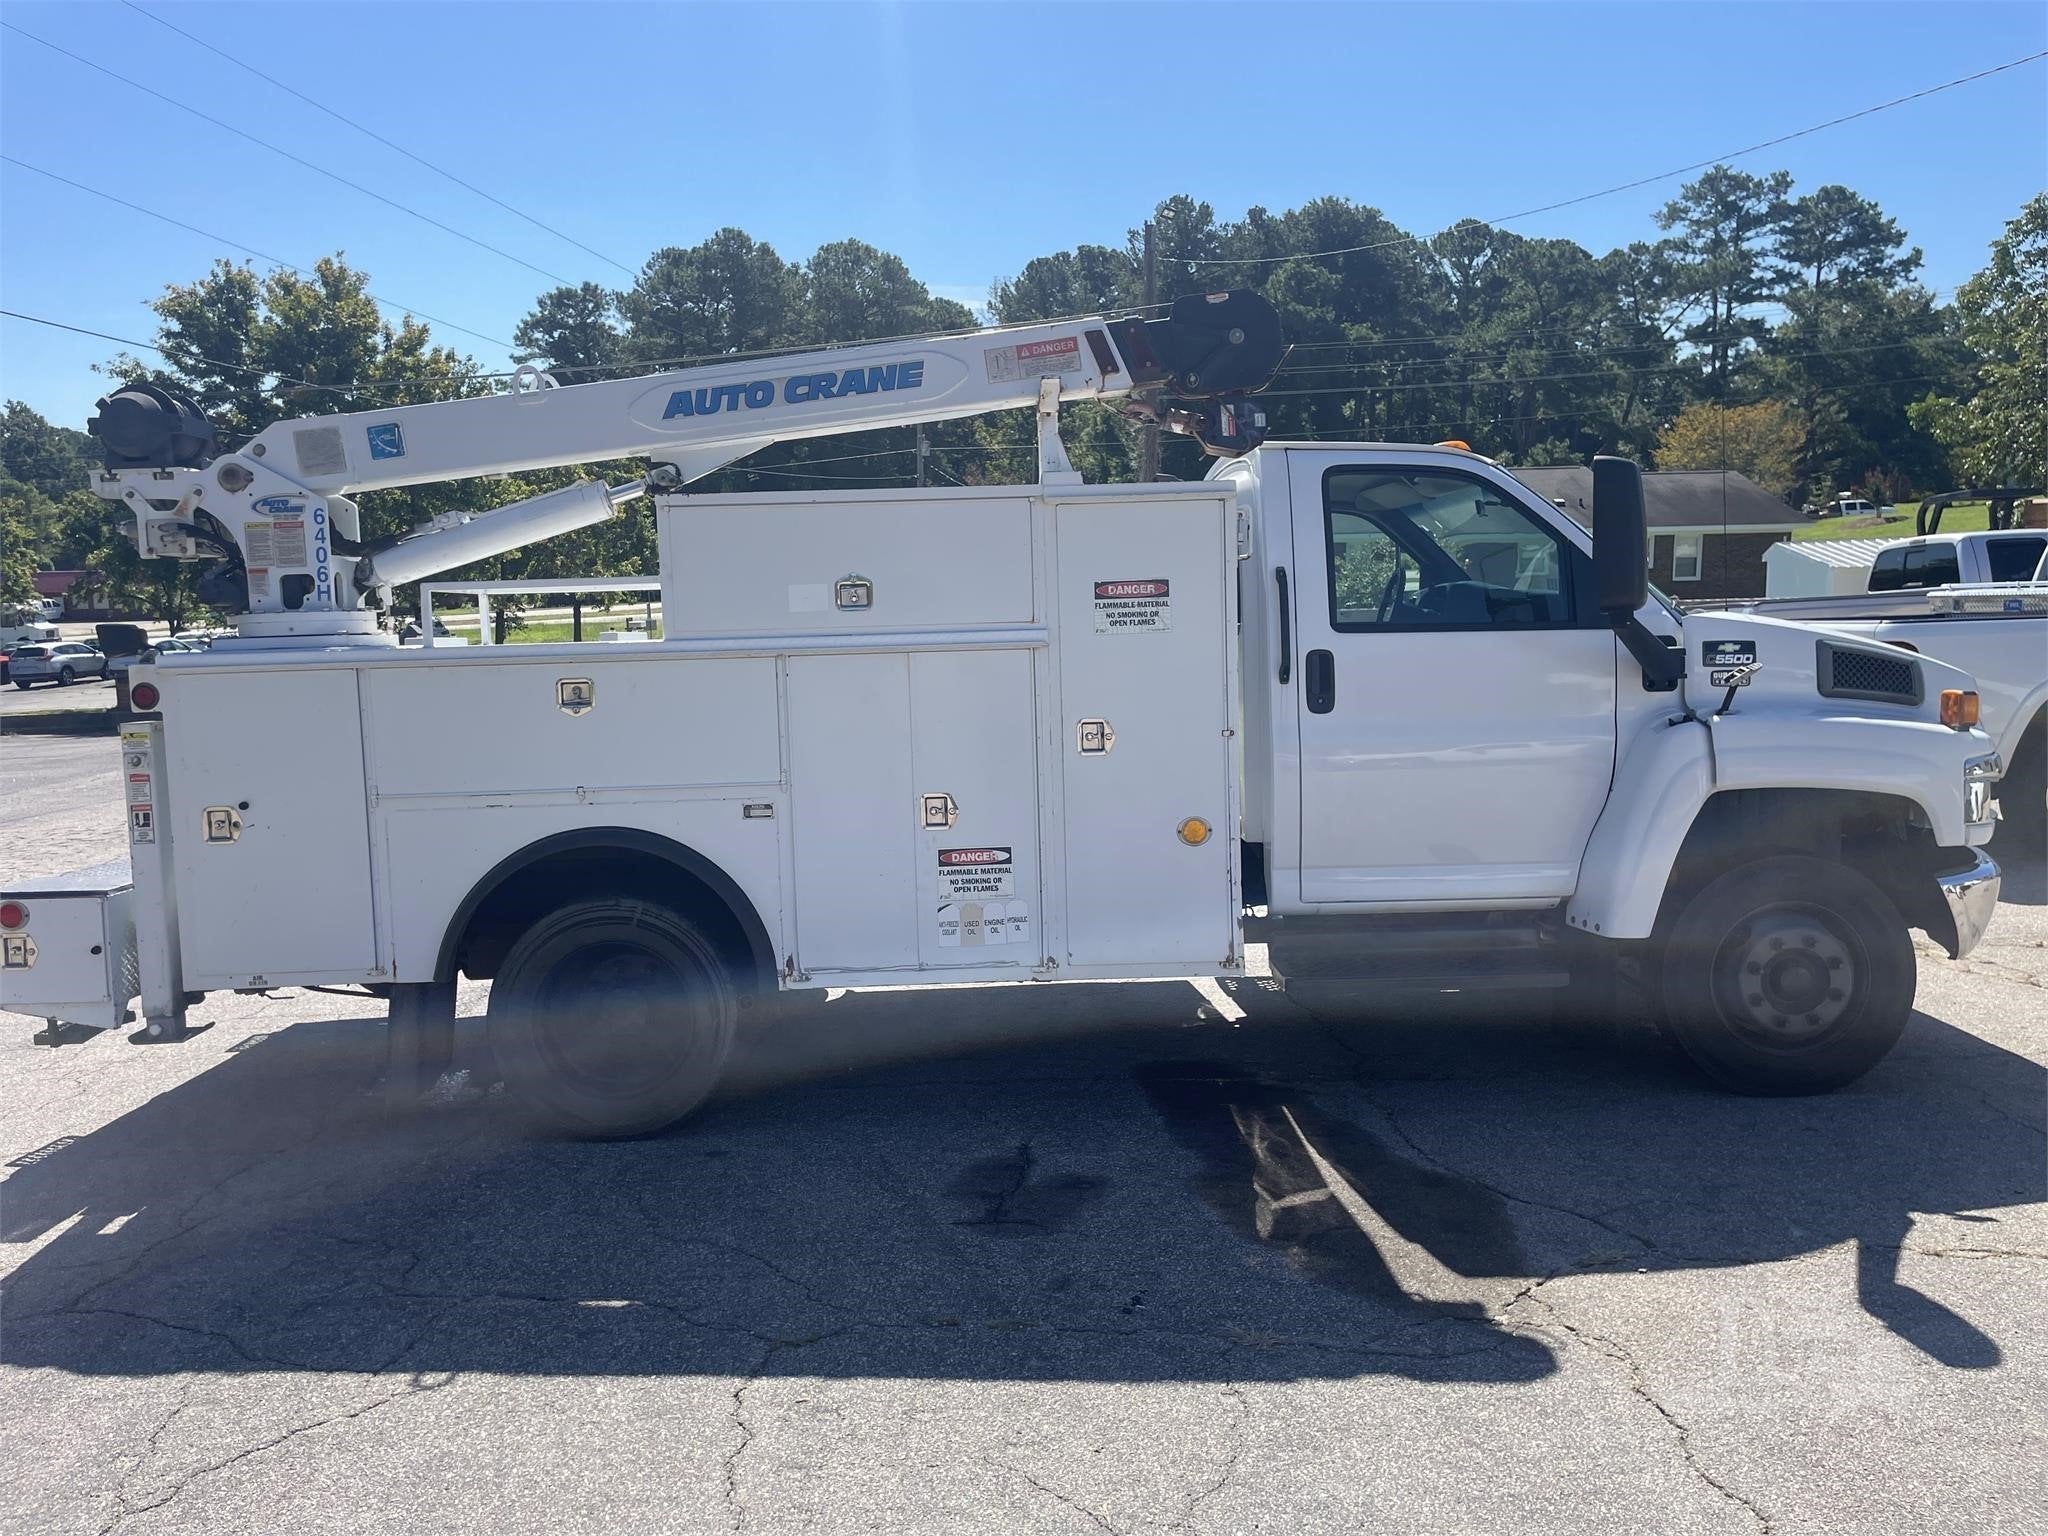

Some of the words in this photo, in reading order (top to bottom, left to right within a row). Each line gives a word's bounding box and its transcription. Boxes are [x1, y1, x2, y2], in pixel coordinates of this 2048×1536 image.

[1032, 340, 1075, 354] DANGER
[662, 380, 775, 420] AUTO
[783, 360, 925, 404] CRANE
[313, 507, 331, 602] 6406H
[1108, 584, 1155, 595] DANGER
[1094, 601, 1136, 610] FLAMMABLE
[1136, 600, 1170, 608] MATERIAL
[1117, 611, 1148, 619] SMOKING
[1149, 610, 1160, 618] OR
[1109, 619, 1128, 627] OPEN
[1129, 618, 1156, 626] FLAMES
[1706, 654, 1753, 664] C5500
[951, 851, 999, 862] DANGER
[938, 868, 979, 877] FLAMMABLE
[980, 867, 1013, 875] MATERIAL
[960, 877, 992, 886] SMOKING
[973, 885, 999, 893] FLAMES
[964, 920, 980, 928] USED
[984, 918, 1005, 926] ENGINE
[967, 928, 976, 936] OIL
[990, 926, 1000, 934] OIL
